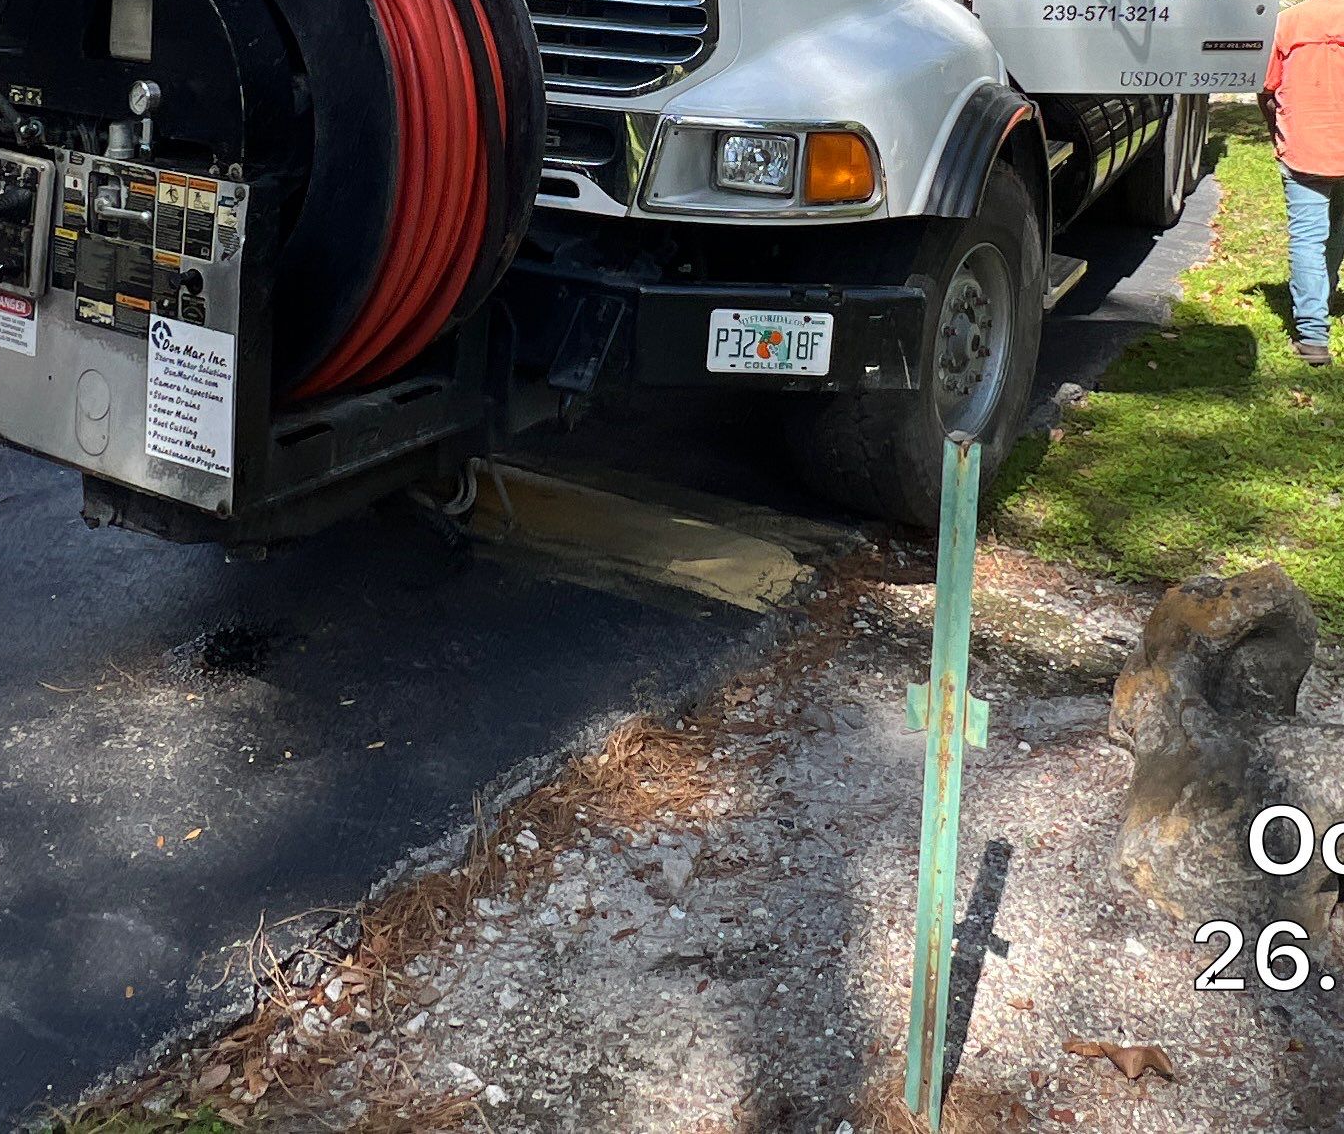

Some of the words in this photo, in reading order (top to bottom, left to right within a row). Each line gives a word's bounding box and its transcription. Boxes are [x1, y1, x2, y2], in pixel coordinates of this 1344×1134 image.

[1042, 4, 1169, 22] 239-571-3214
[1119, 71, 1187, 87] USDOT
[1191, 72, 1256, 87] 3957234
[162, 339, 181, 355] Don
[183, 345, 206, 364] Mar,
[208, 351, 228, 368] Inc.
[715, 328, 756, 358] P32
[785, 330, 824, 361] 18F
[154, 352, 175, 365] Storm
[177, 358, 197, 370] Water
[197, 364, 232, 381] Solutions
[744, 361, 793, 370] COLLIER
[153, 376, 181, 392] Camera
[182, 385, 224, 403] Inspections
[153, 390, 174, 403] Storm
[176, 397, 201, 411] Drains
[153, 404, 174, 416] Sewer
[175, 410, 198, 423] Mains
[152, 417, 169, 429] Root
[169, 422, 198, 439] Cutting
[152, 430, 183, 446] Pressure
[184, 439, 216, 458] Washing
[196, 457, 230, 473] Programs
